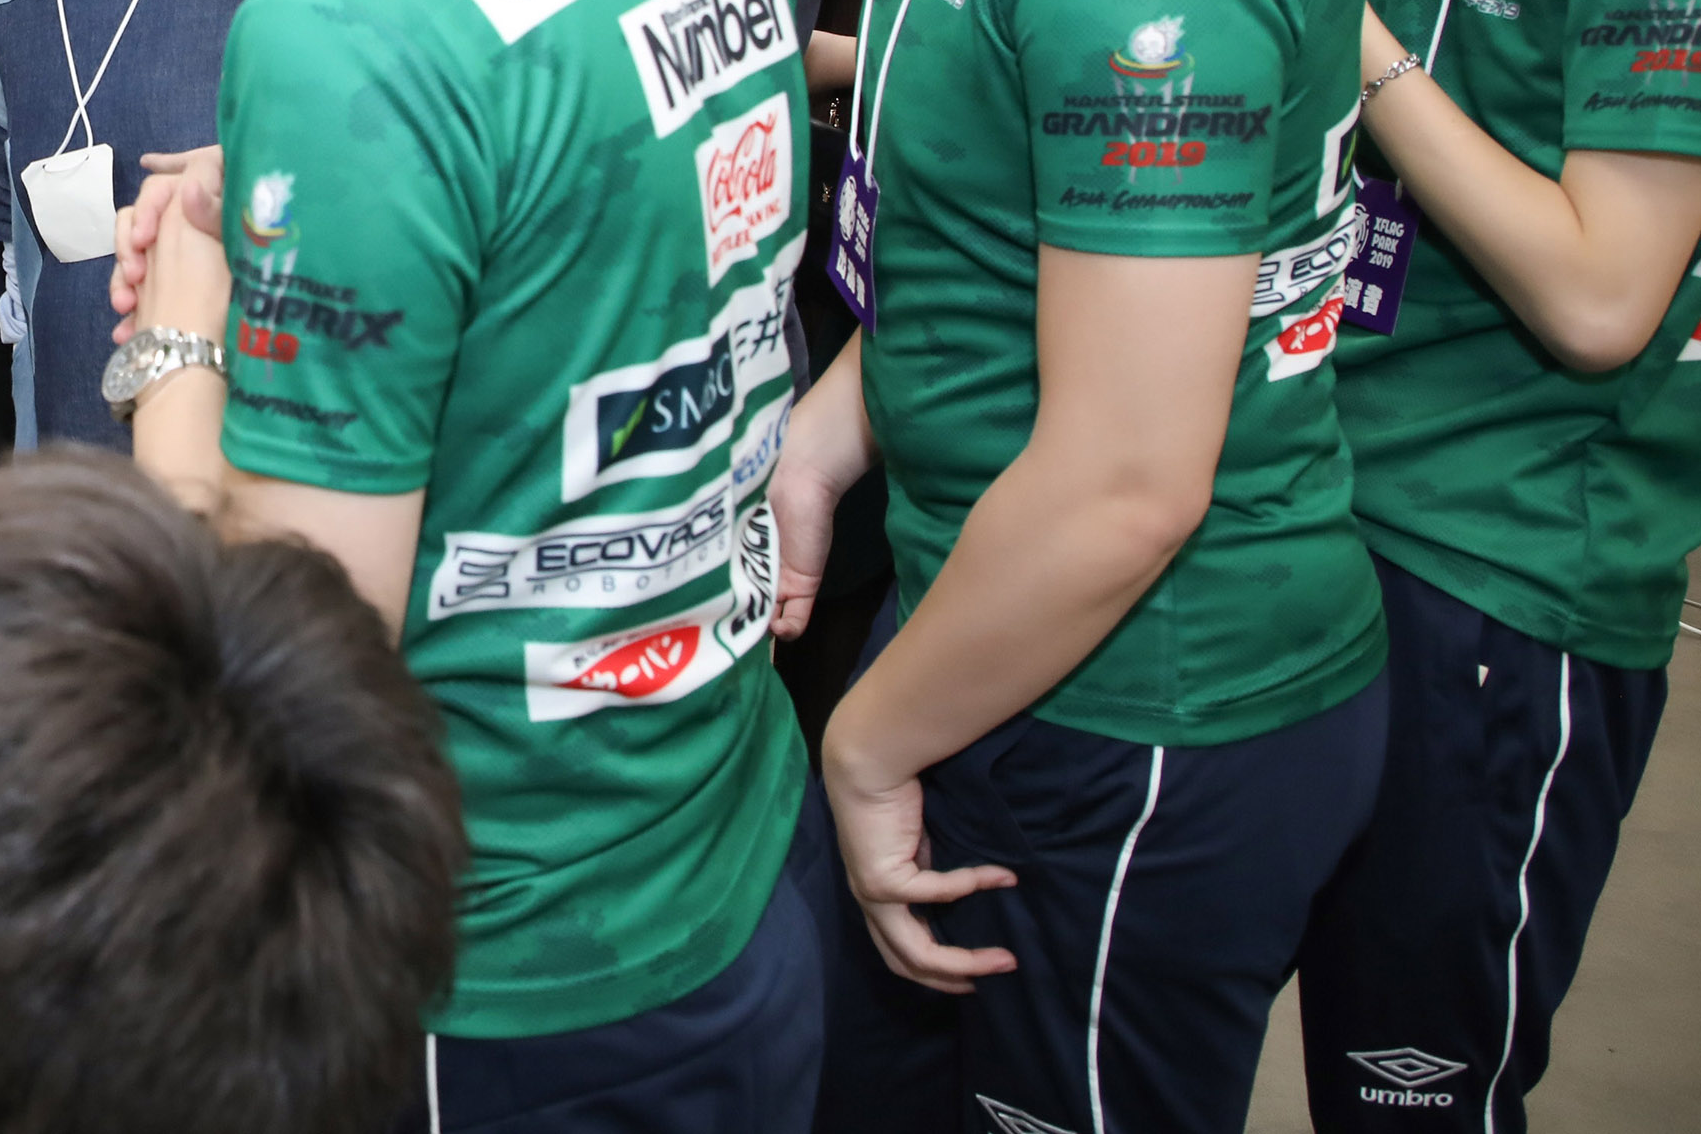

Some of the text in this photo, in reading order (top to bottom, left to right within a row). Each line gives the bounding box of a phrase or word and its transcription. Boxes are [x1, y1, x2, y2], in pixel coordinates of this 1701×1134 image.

[1102, 141, 1207, 168] 2019
[1373, 216, 1405, 238] XFLAG
[1371, 234, 1399, 254] PARK
[1368, 251, 1394, 270] 2019
[1344, 276, 1384, 316] 演者
[536, 498, 726, 573] ECOVACS
[1360, 1086, 1453, 1107] umbro
